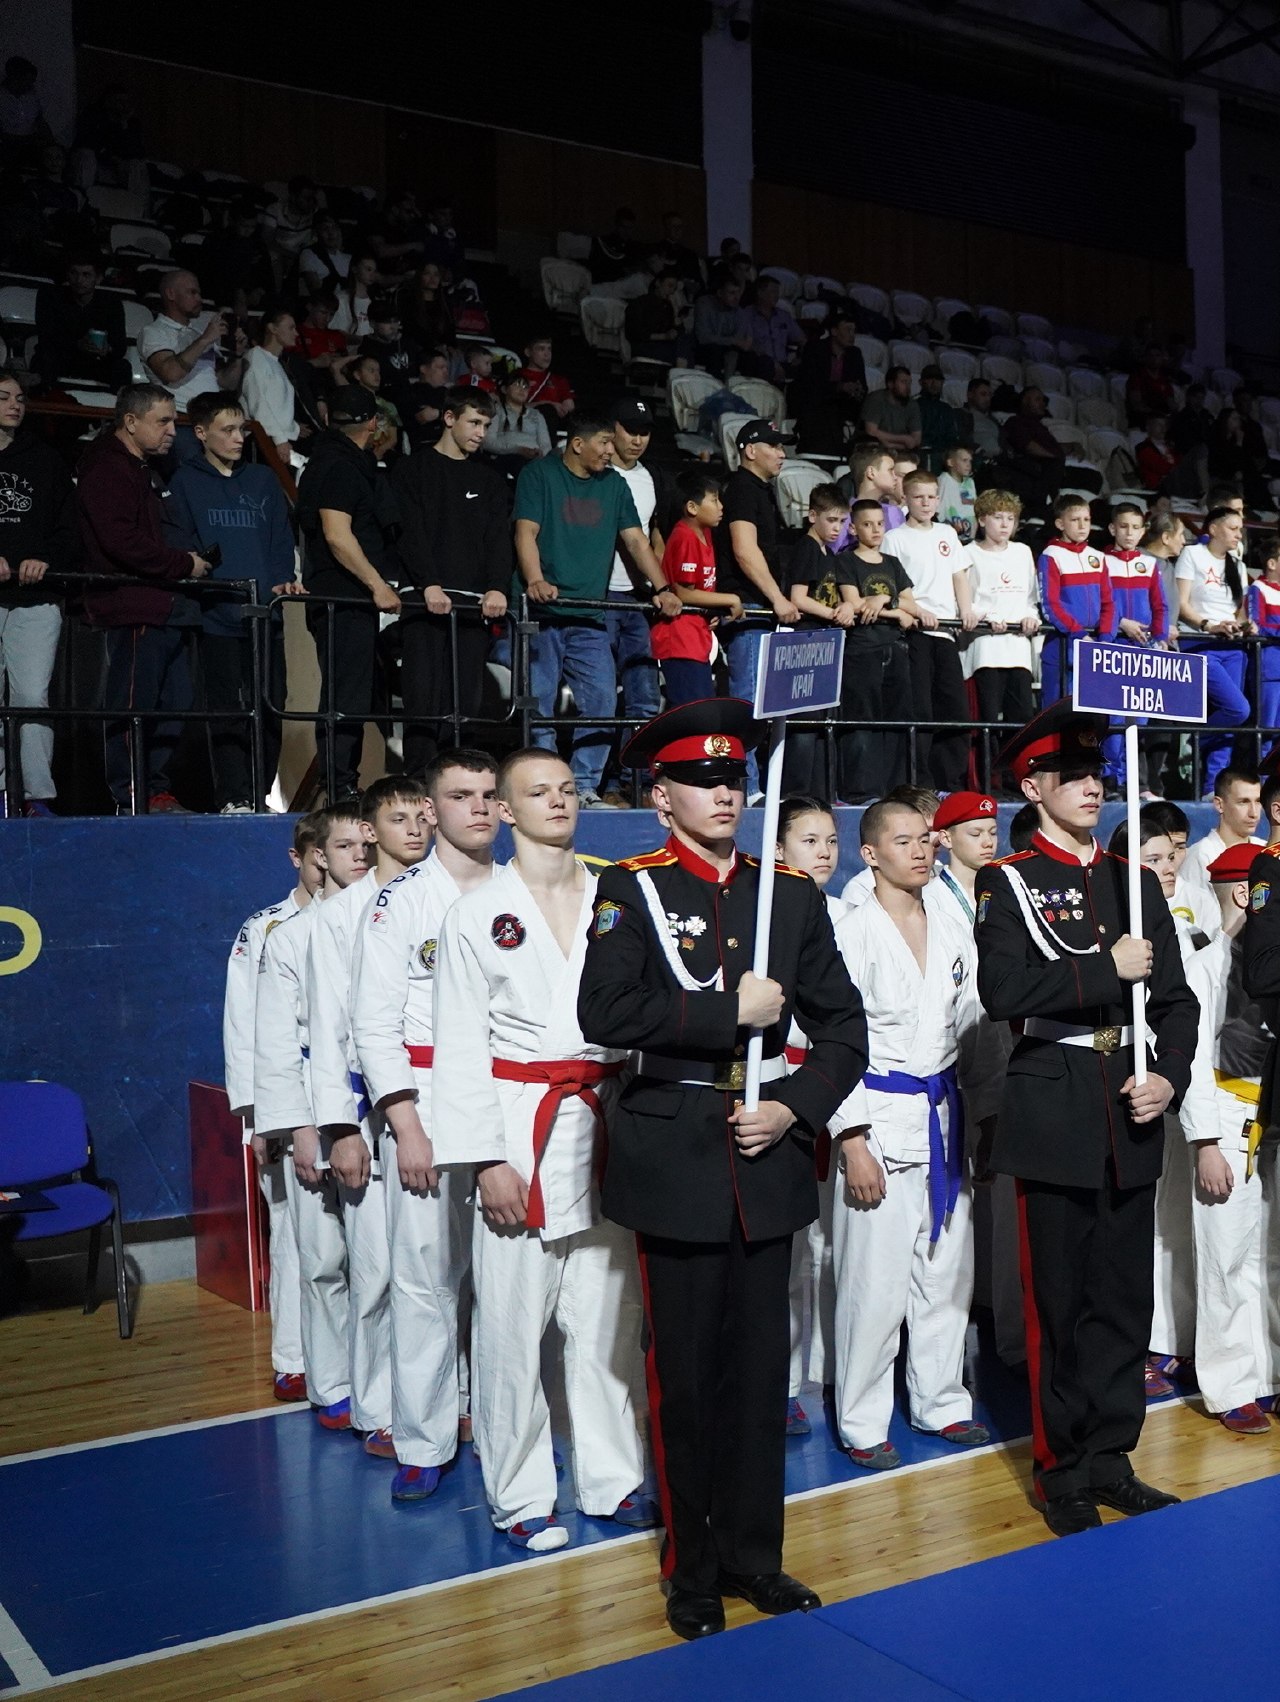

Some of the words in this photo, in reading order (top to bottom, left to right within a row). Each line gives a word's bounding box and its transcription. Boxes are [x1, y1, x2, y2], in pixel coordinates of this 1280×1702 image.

[773, 637, 836, 672] КРАСНОЯРСКИЙ
[1092, 648, 1193, 683] РЕСПУБЛИКА
[791, 669, 815, 699] КРАЙ
[1121, 685, 1165, 713] ТЫВА
